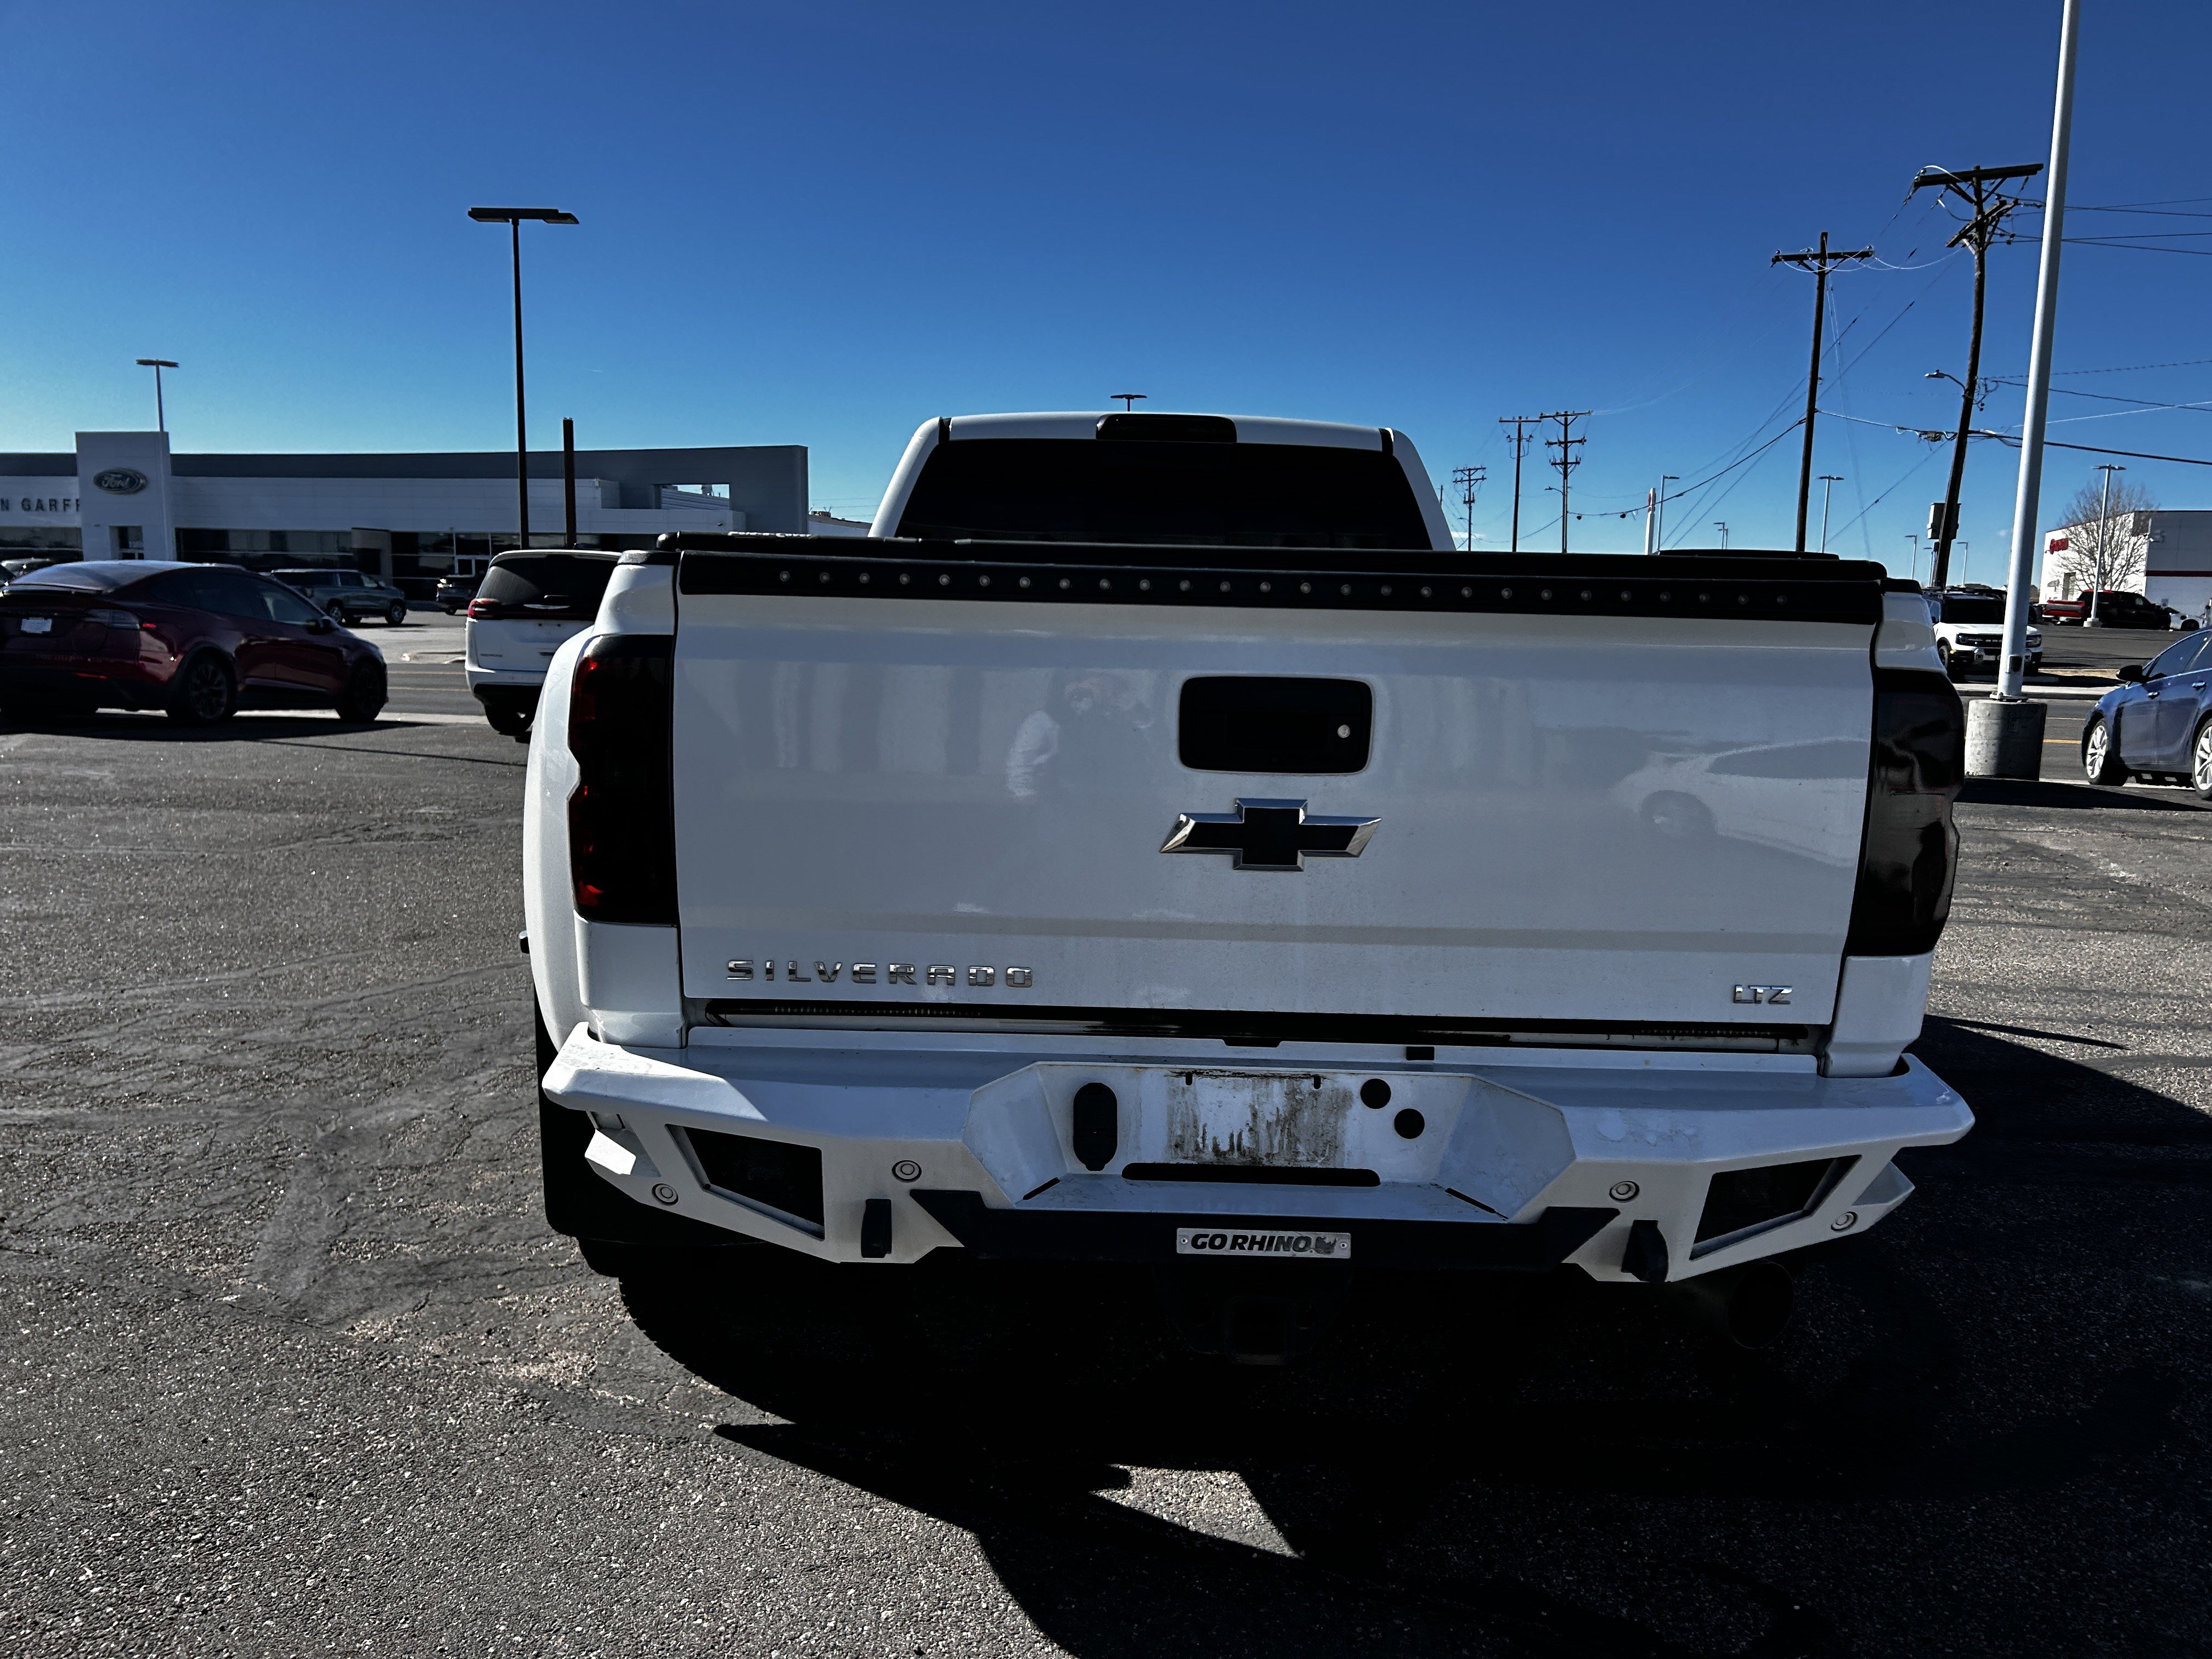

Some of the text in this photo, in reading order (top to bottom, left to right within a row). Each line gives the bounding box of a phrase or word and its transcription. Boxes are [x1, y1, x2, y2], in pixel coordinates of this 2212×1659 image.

[727, 960, 1034, 988] SILVERADO
[1733, 984, 1793, 1005] LTZ
[1190, 1233, 1312, 1252] GO RHINO
